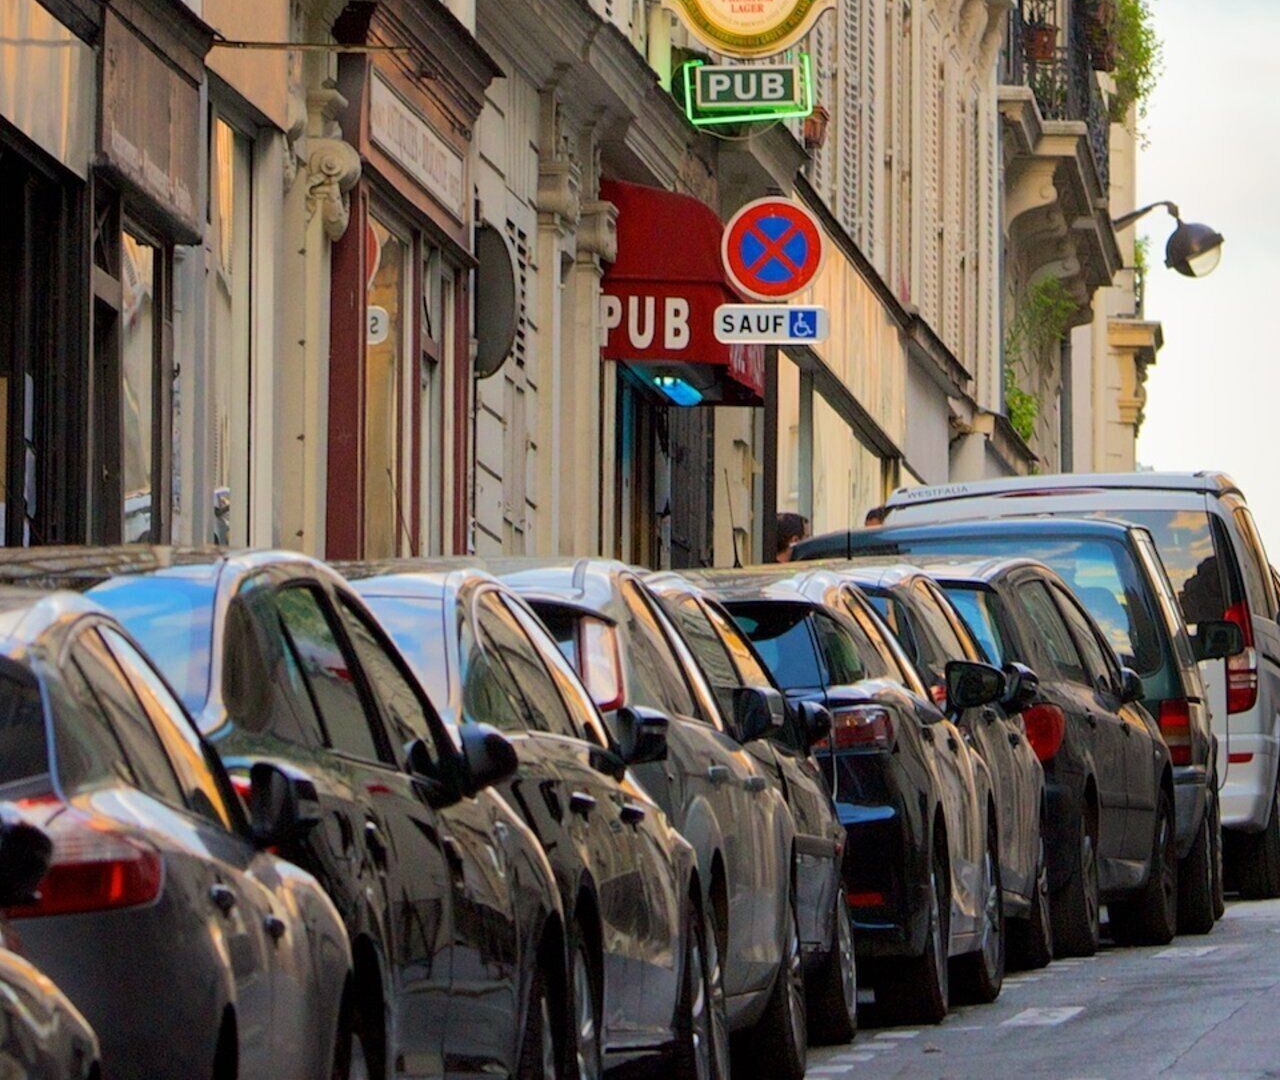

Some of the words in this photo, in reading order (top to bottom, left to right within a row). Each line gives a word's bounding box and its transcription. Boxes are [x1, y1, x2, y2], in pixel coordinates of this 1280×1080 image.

[731, 3, 765, 13] LAGER
[708, 72, 785, 101] PUB
[600, 295, 691, 350] PUB
[722, 314, 785, 334] SAUF
[907, 485, 969, 499] WESTFALIA
